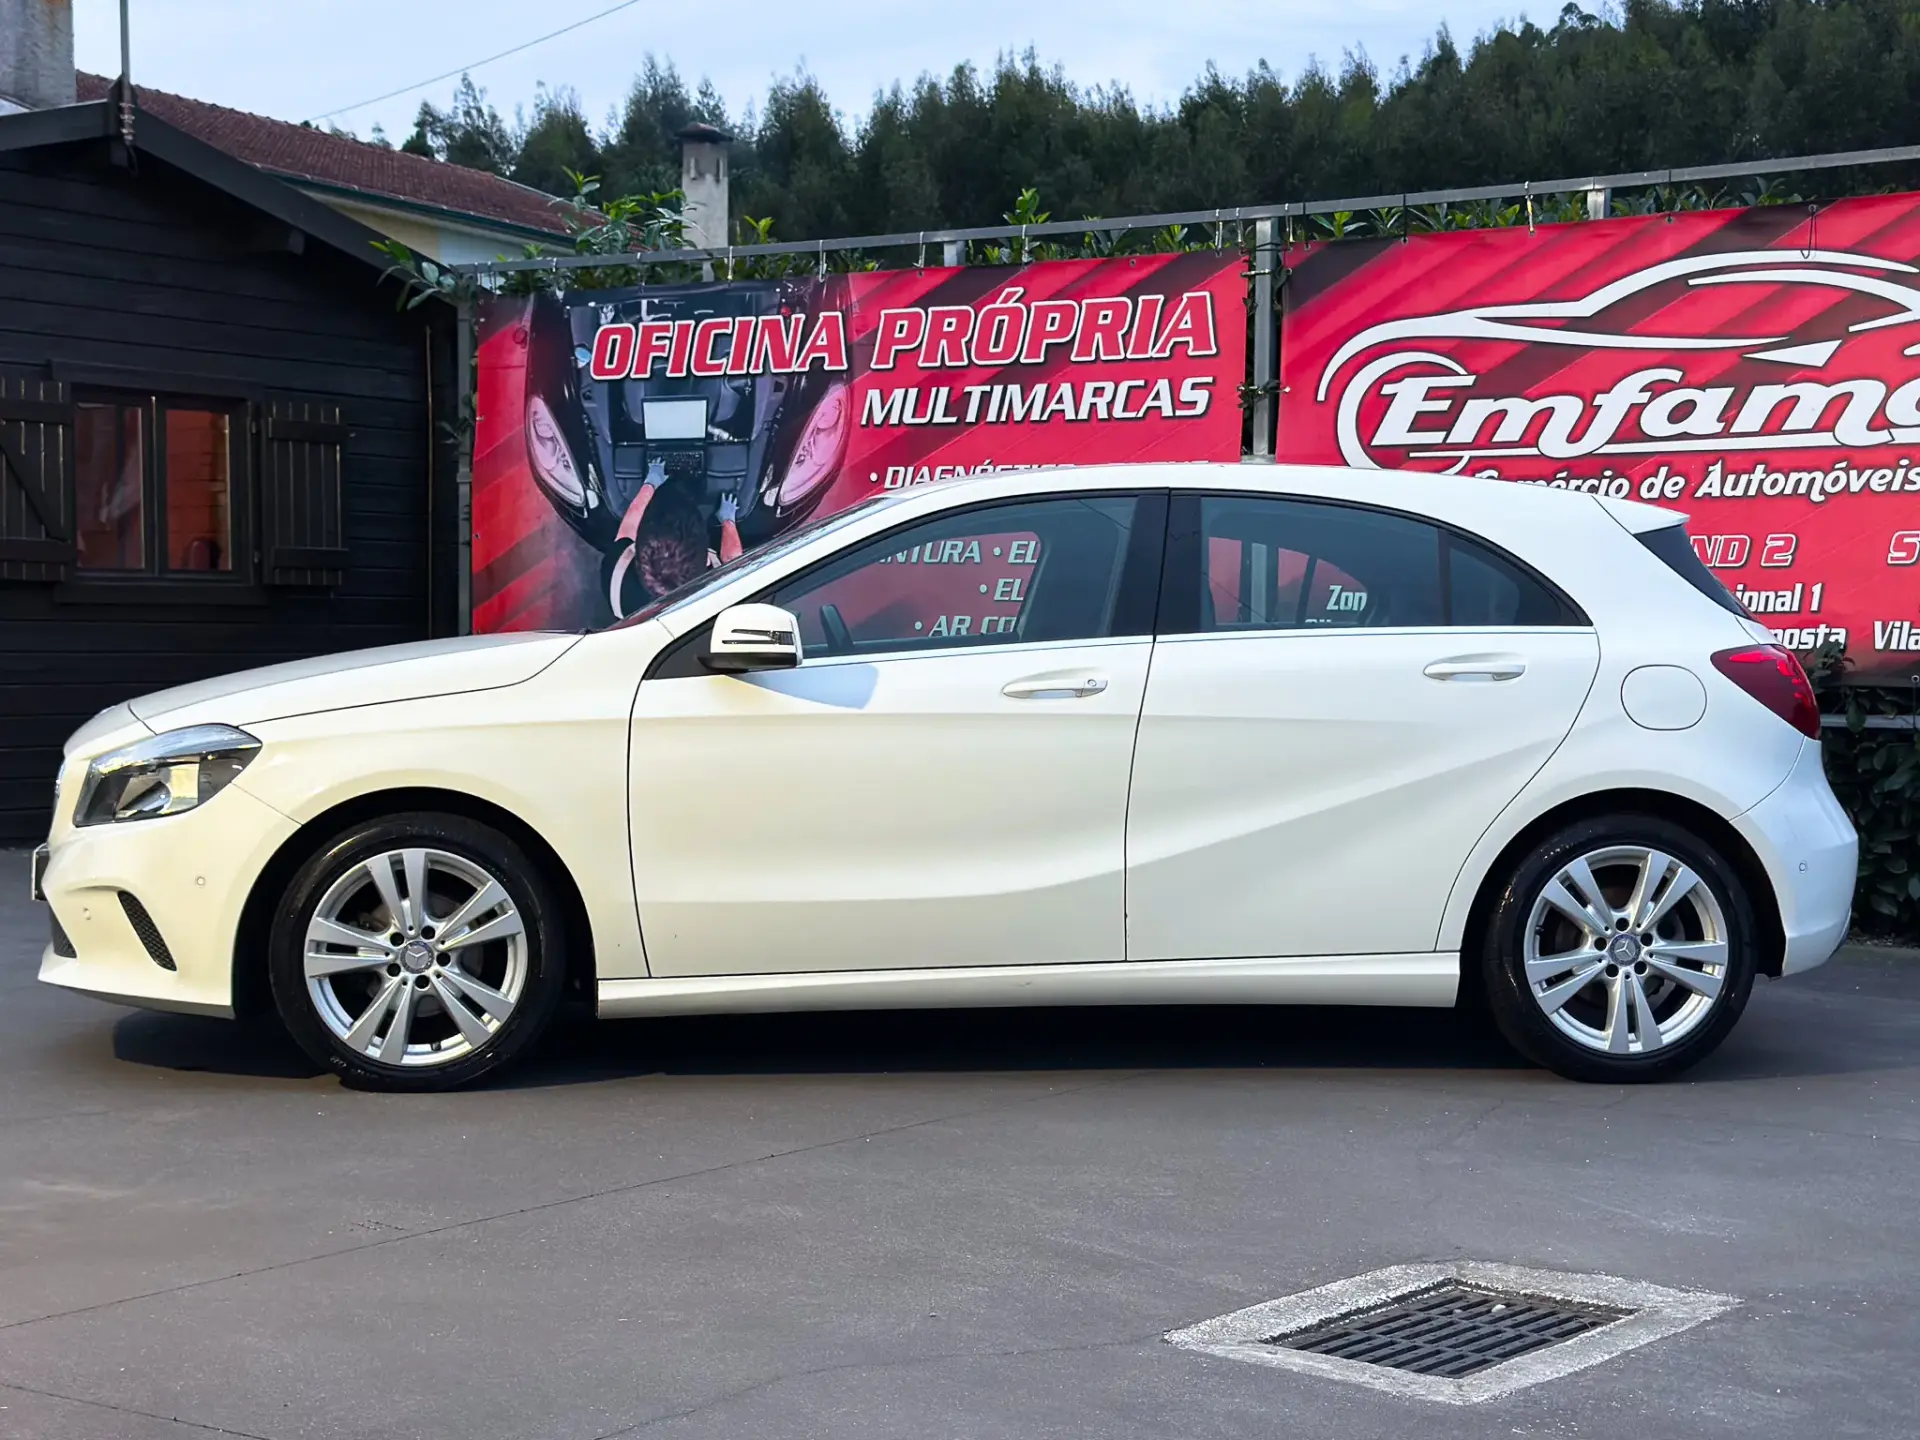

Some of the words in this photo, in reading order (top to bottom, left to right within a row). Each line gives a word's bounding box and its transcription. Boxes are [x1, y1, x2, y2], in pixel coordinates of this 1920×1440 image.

[590, 311, 848, 380] OFICINA
[870, 287, 1217, 369] PRÓPRIA
[861, 376, 1213, 425] MULTIMARCAS
[1639, 466, 1686, 499] de
[1761, 533, 1796, 567] 2
[1733, 583, 1803, 612] ional
[1810, 582, 1823, 611] 1
[928, 615, 972, 637] AR
